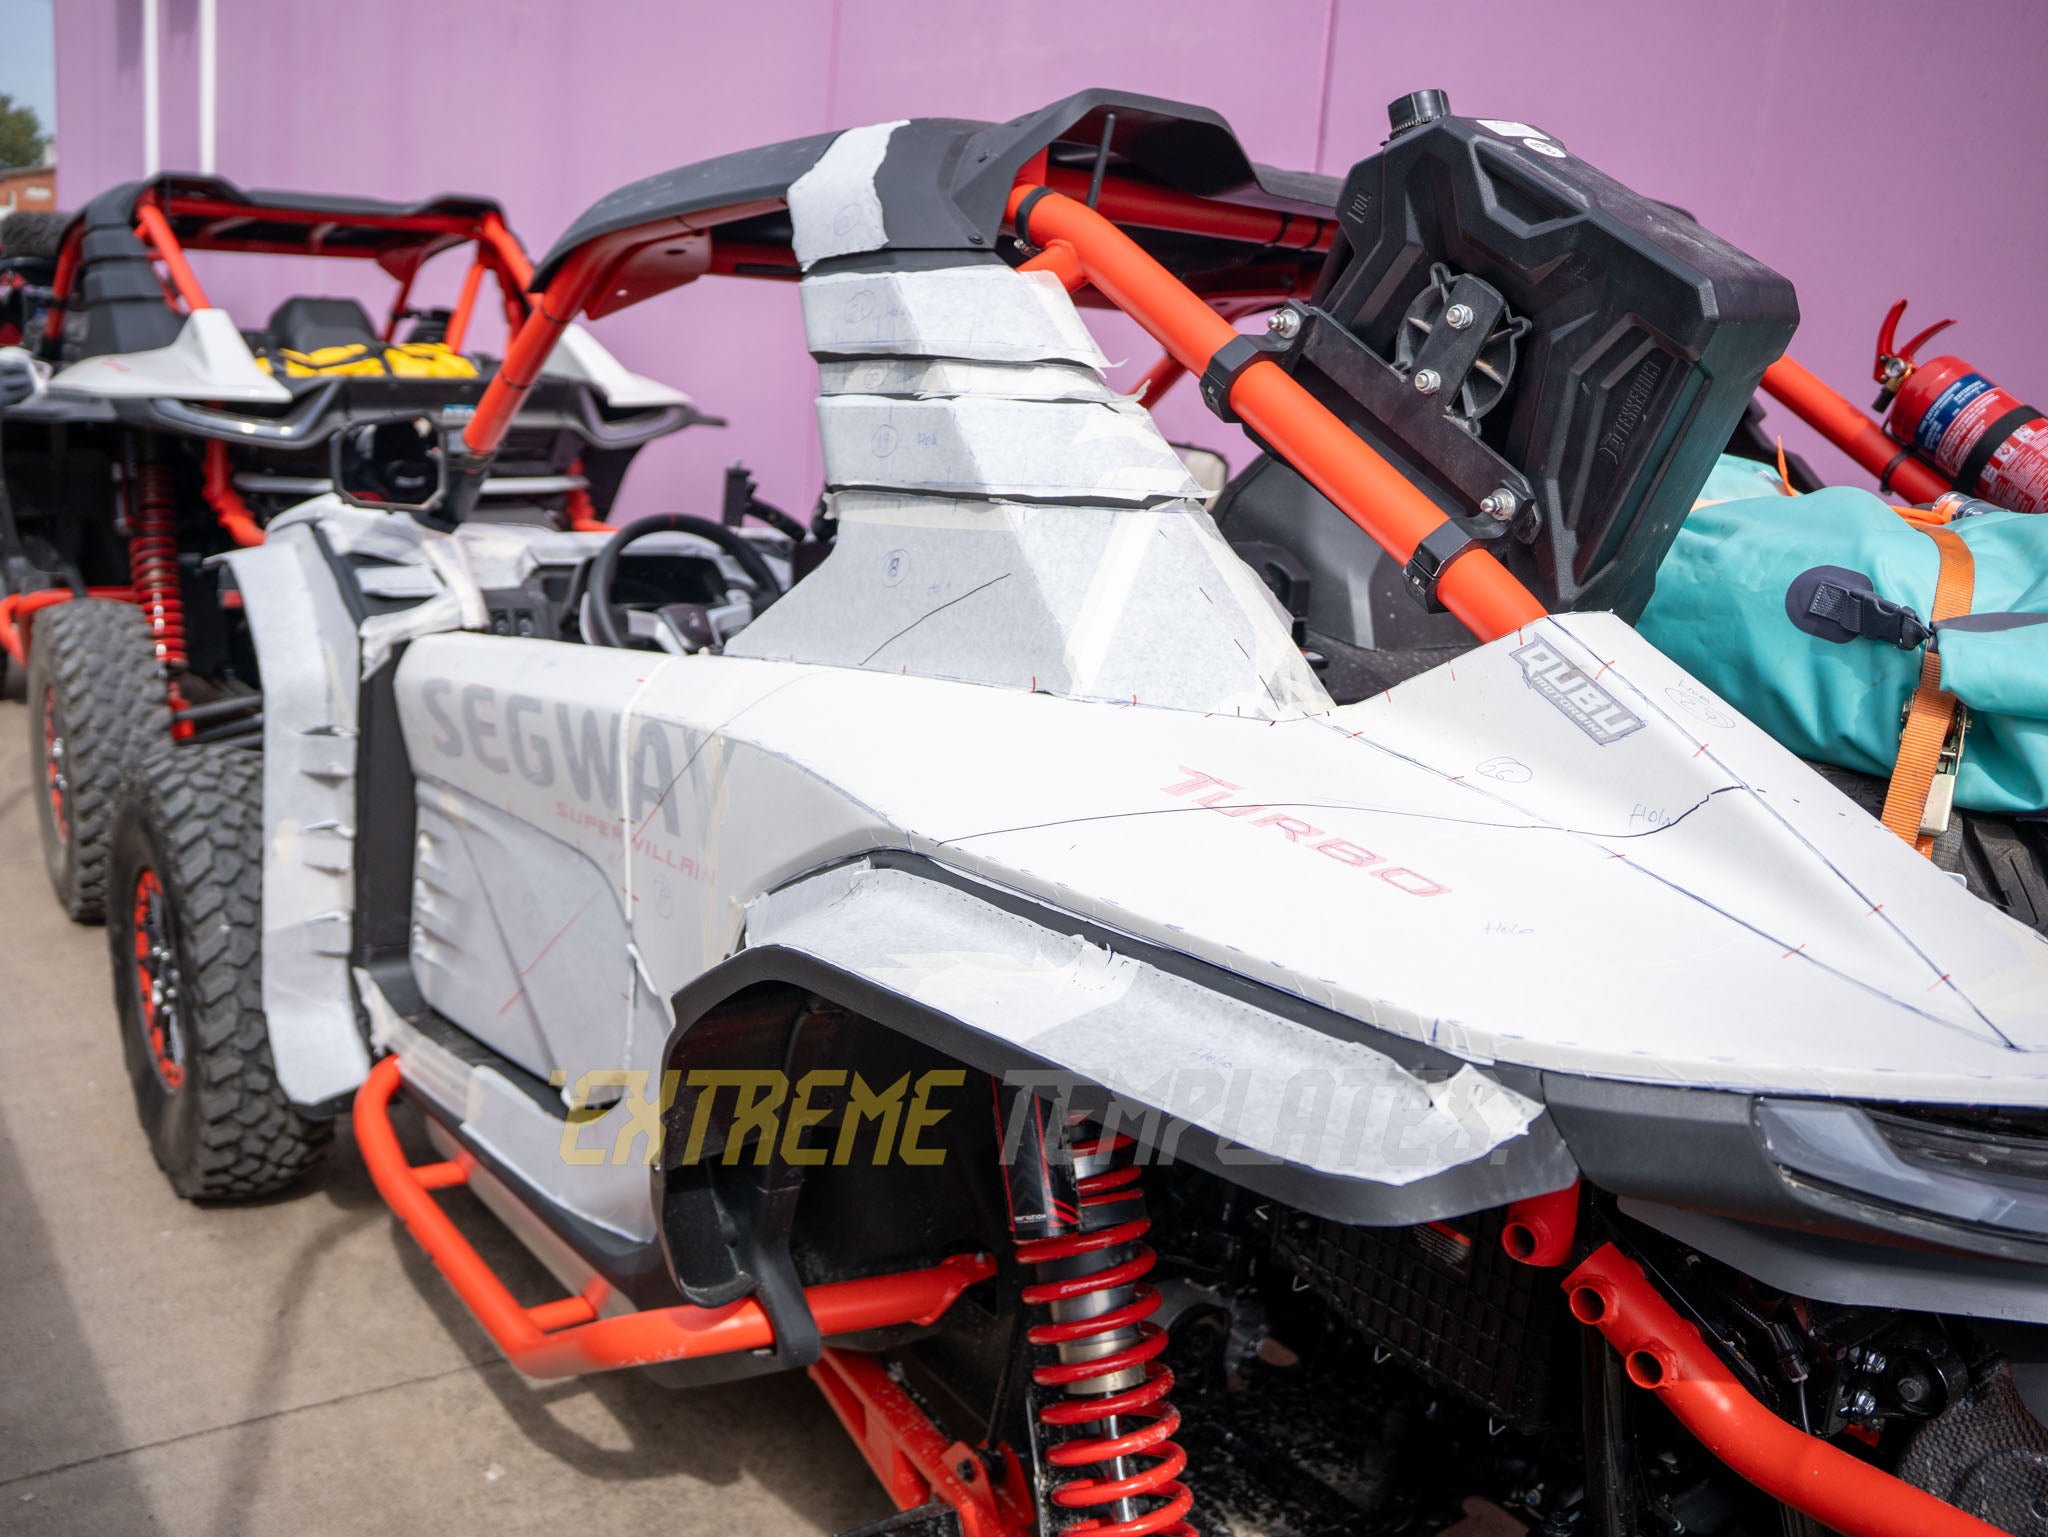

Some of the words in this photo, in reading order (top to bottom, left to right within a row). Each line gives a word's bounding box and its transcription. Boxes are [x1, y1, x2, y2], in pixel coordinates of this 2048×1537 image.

[1520, 643, 1638, 735] QUBU
[1532, 676, 1609, 741] MOTORBIKE
[422, 678, 737, 850] SEGWAY
[554, 801, 625, 843] SUPER
[632, 836, 716, 886] VILLAIN
[1160, 765, 1452, 897] TURBO
